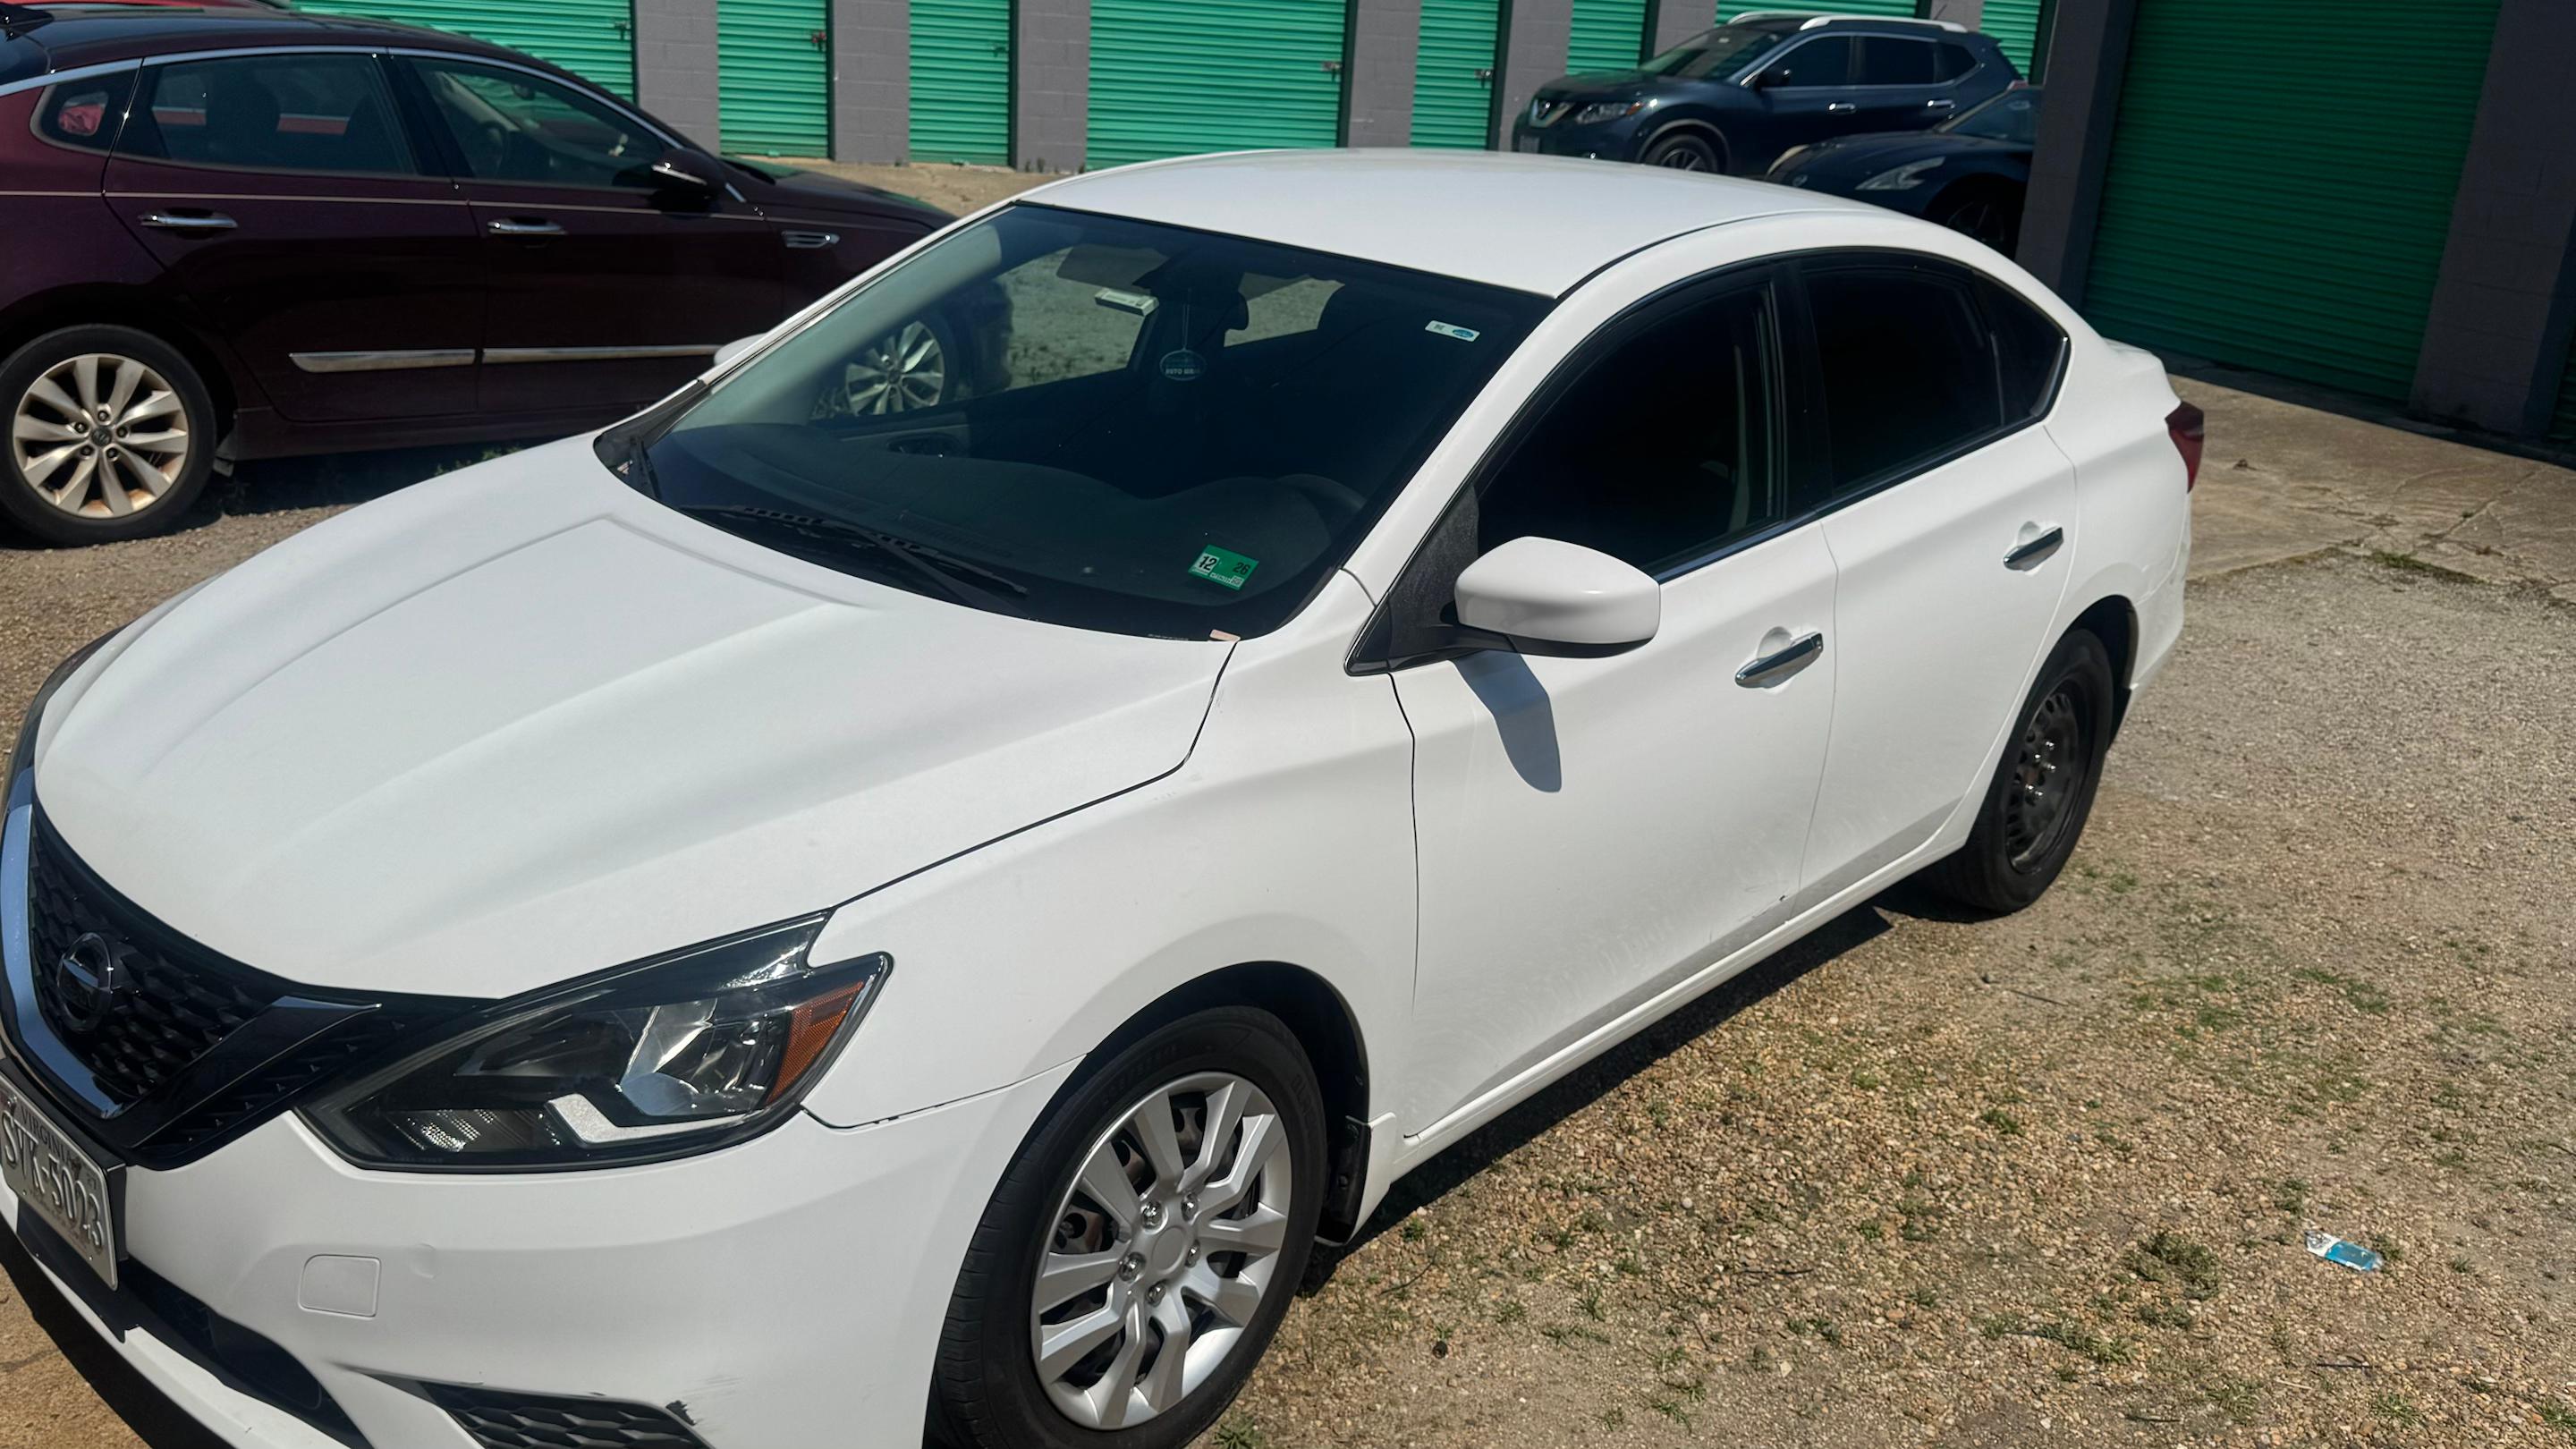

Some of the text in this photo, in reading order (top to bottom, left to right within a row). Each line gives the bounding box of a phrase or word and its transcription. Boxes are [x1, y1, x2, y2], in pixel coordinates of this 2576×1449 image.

[1199, 555, 1250, 575] 12 26
[21, 1106, 76, 1165] VIRGINIA
